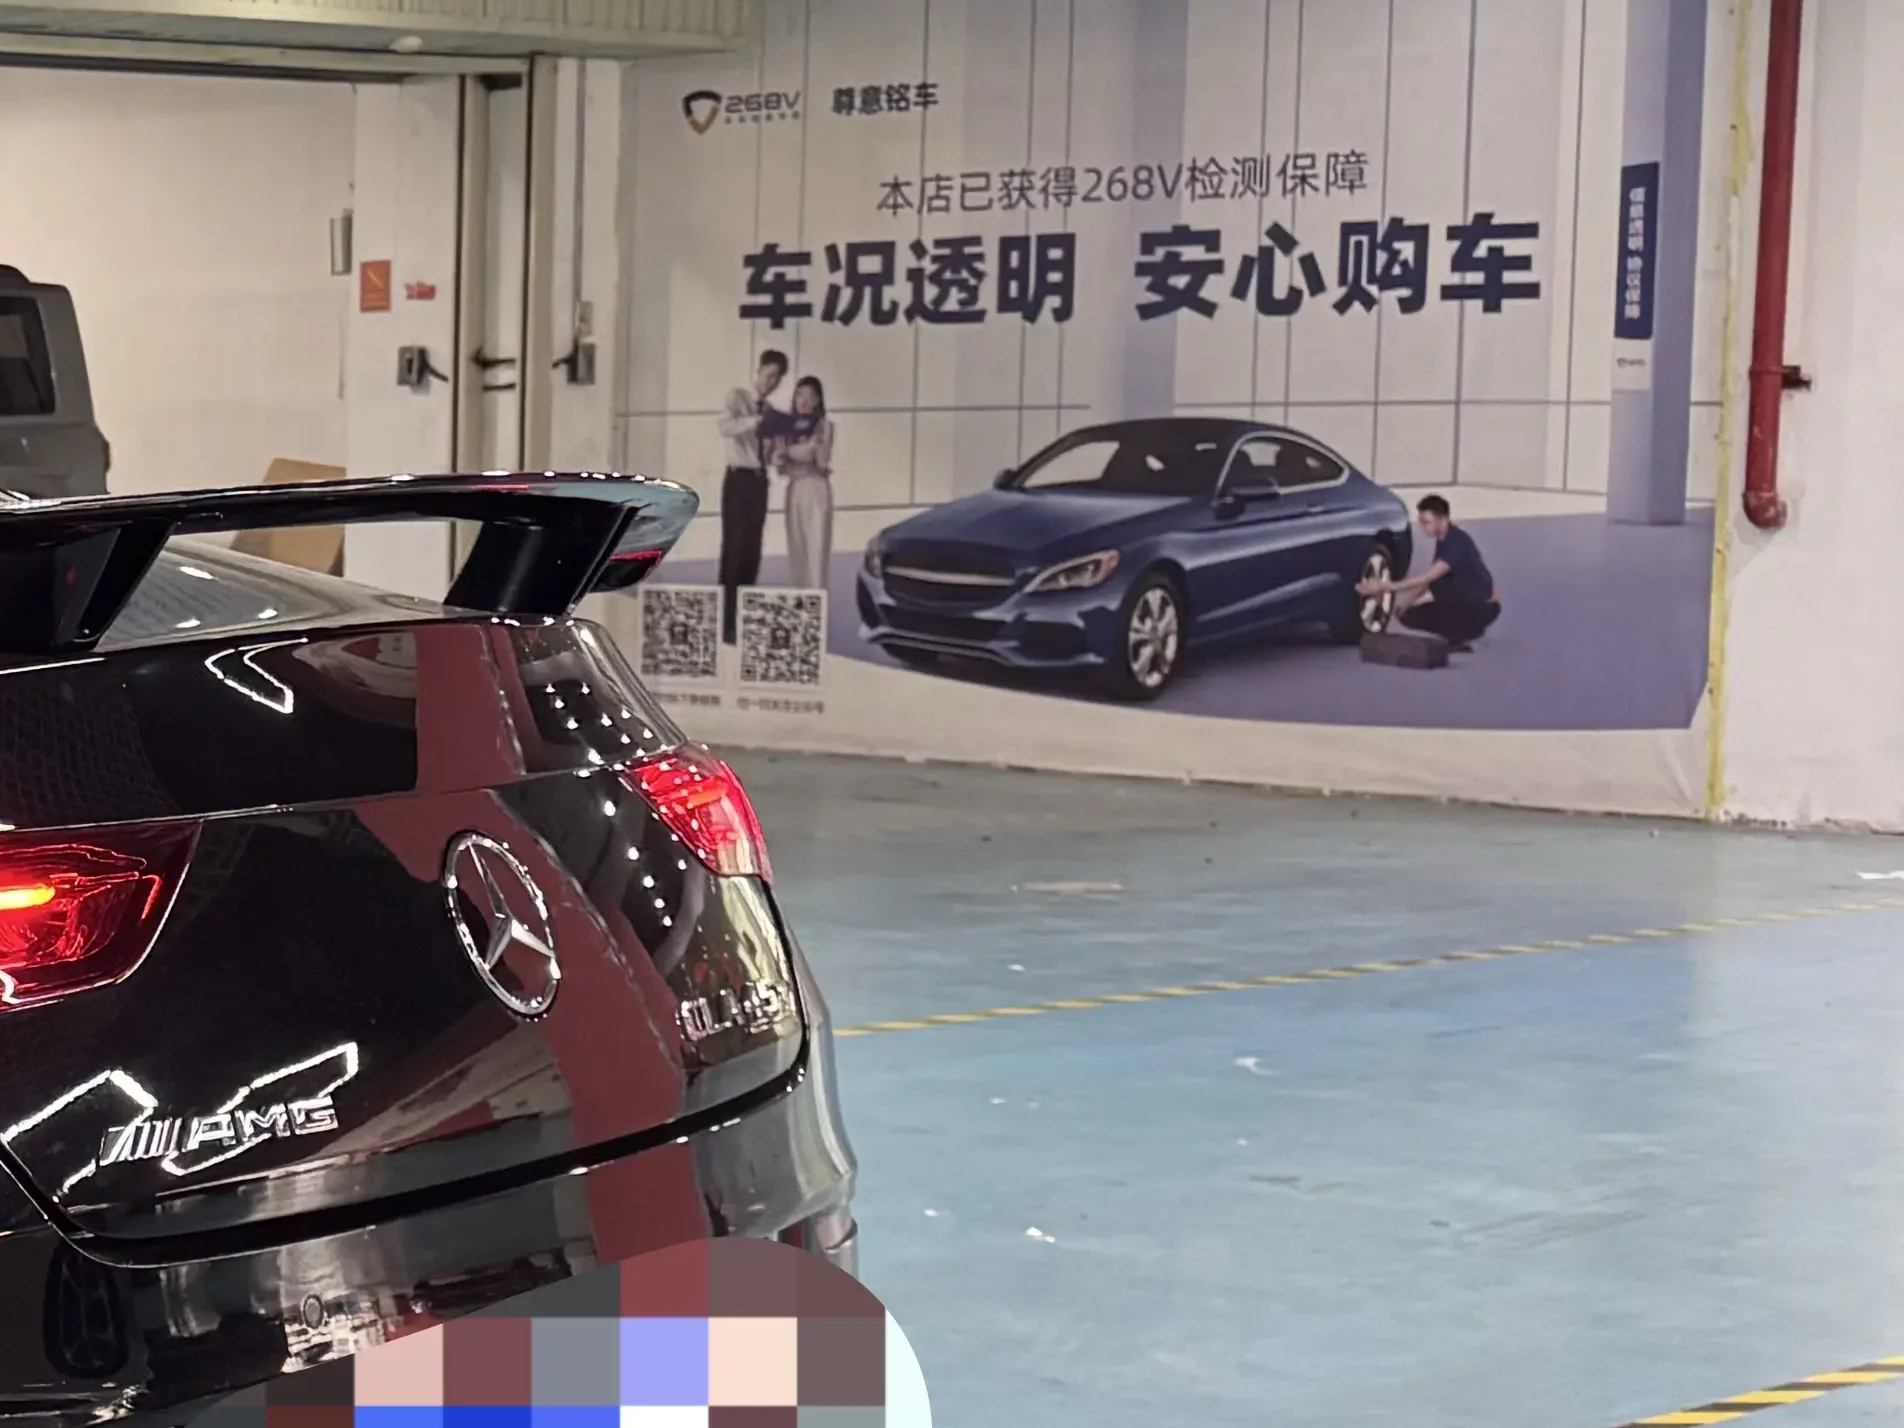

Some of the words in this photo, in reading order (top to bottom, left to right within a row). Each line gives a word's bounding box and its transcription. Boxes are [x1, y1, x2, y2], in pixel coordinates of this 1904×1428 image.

[725, 90, 801, 113] 268V
[876, 149, 1370, 216] 本店已获得268V检测保障
[739, 232, 1077, 329] 车况透明
[1135, 212, 1542, 320] 安心购车
[181, 1096, 339, 1152] AMG
